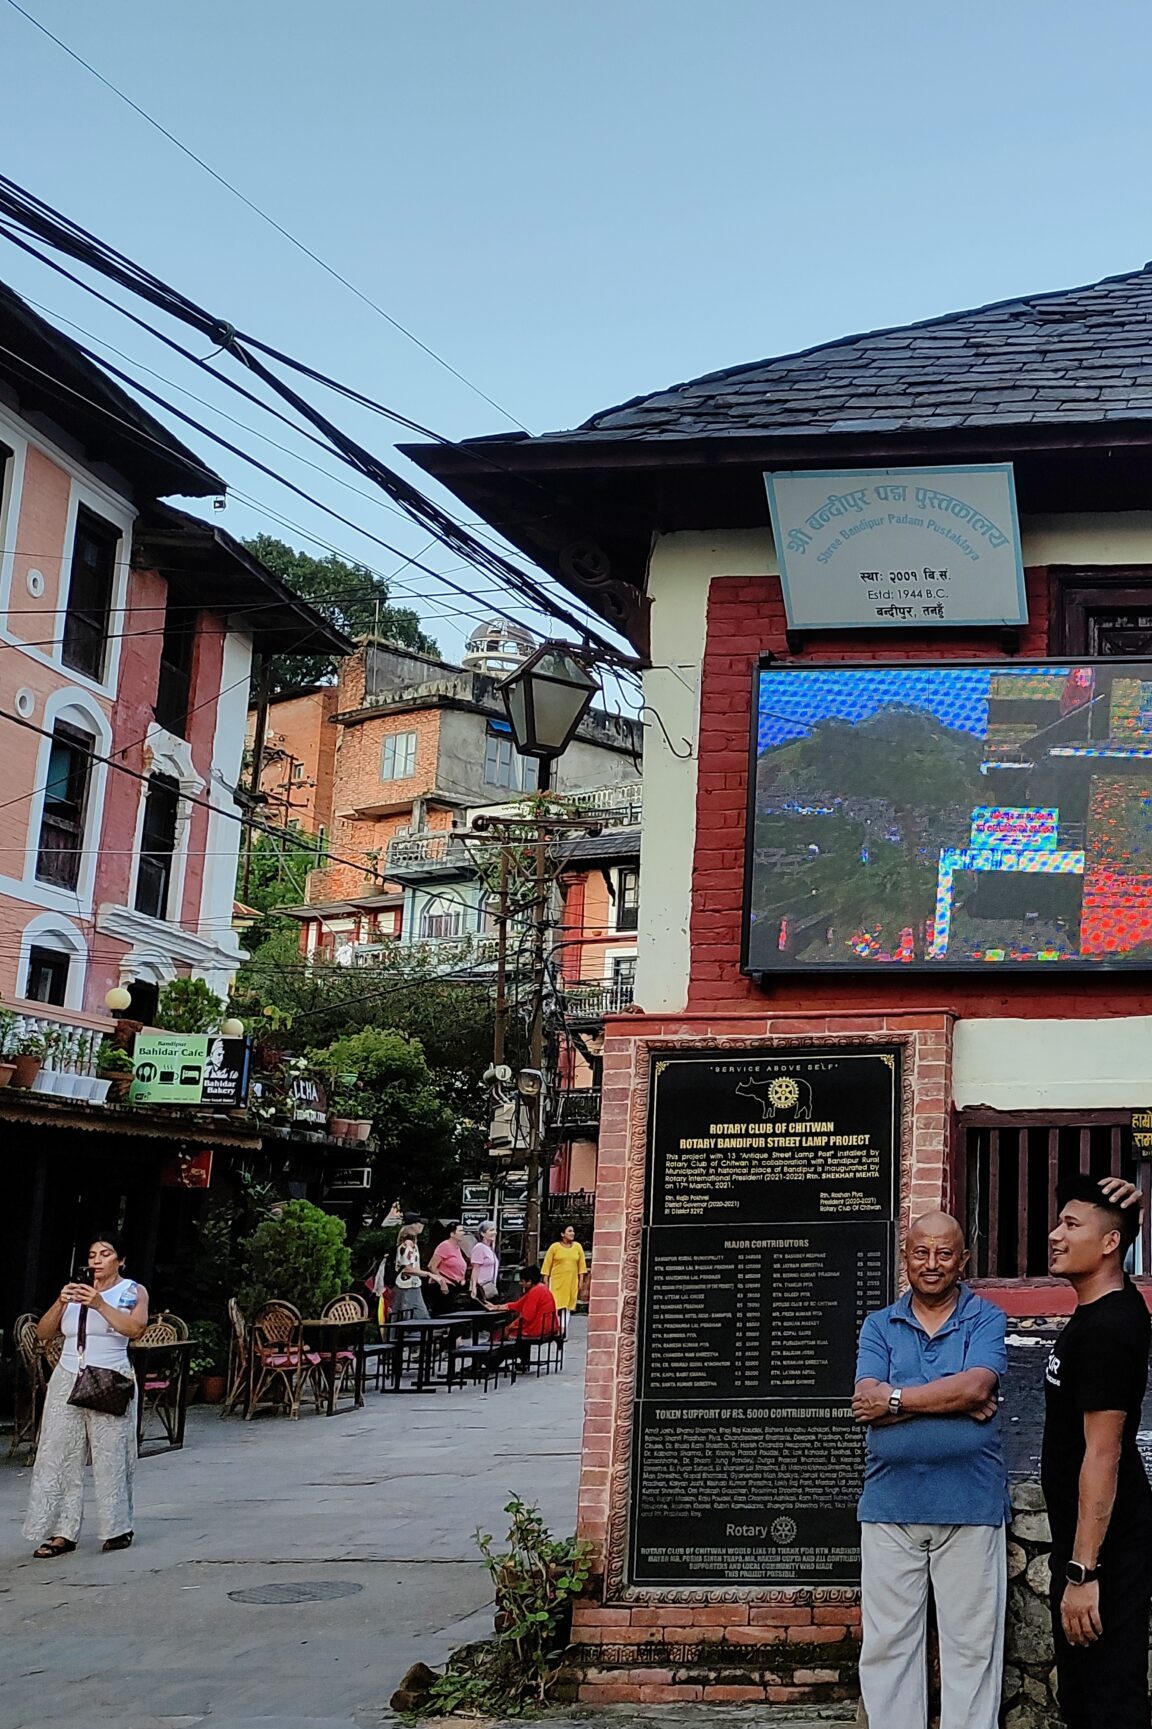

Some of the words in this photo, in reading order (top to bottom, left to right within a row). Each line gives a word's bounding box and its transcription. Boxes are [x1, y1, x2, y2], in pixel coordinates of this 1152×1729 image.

[787, 528, 813, 554] श्री
[804, 488, 871, 530] बन्दीपुर
[915, 487, 1010, 549] पुस्तकालय
[817, 538, 842, 564] Shree
[840, 517, 885, 540] Bandipur
[888, 514, 923, 526] Padam
[927, 519, 980, 562] Pustaklaya
[868, 590, 894, 600] Estd:
[898, 590, 923, 600] 1944
[926, 589, 949, 599] B.C.
[139, 1048, 179, 1057] Bahidar
[181, 1049, 204, 1057] Cafe
[766, 1064, 801, 1072] ABOVE
[204, 1079, 236, 1087] Bahidar
[207, 1087, 236, 1096] Bakery
[710, 1123, 746, 1135] ROTARY
[748, 1122, 774, 1135] CLUB
[775, 1122, 787, 1134] OF
[789, 1121, 834, 1133] CHITWAN
[680, 1139, 716, 1149] ROTARY
[717, 1138, 765, 1149] BANDIPUR
[767, 1137, 801, 1148] STREET
[802, 1136, 828, 1147] LAMP
[830, 1134, 870, 1146] PROJECT
[682, 1153, 706, 1161] project
[795, 1151, 814, 1159] Lamp
[870, 1149, 880, 1157] by
[665, 1160, 688, 1168] Rotary
[811, 1157, 825, 1165] with
[827, 1157, 859, 1165] Bandipur
[665, 1168, 707, 1176] Municipality
[824, 1164, 868, 1173] inaugurated
[870, 1164, 880, 1172] by
[665, 1175, 687, 1183] Rotary
[688, 1174, 731, 1182] International
[856, 1171, 880, 1179] MEHTA
[689, 1182, 714, 1190] March,
[724, 1240, 751, 1249] MAJOR
[751, 1239, 810, 1248] CONTRIBUTORS
[655, 1409, 681, 1419] TOKEN
[683, 1409, 720, 1419] SUPPORT
[721, 1409, 732, 1419] OF
[747, 1408, 768, 1418] 5000
[770, 1408, 830, 1418] CONTRIBUTING
[726, 1523, 768, 1538] Rotary
